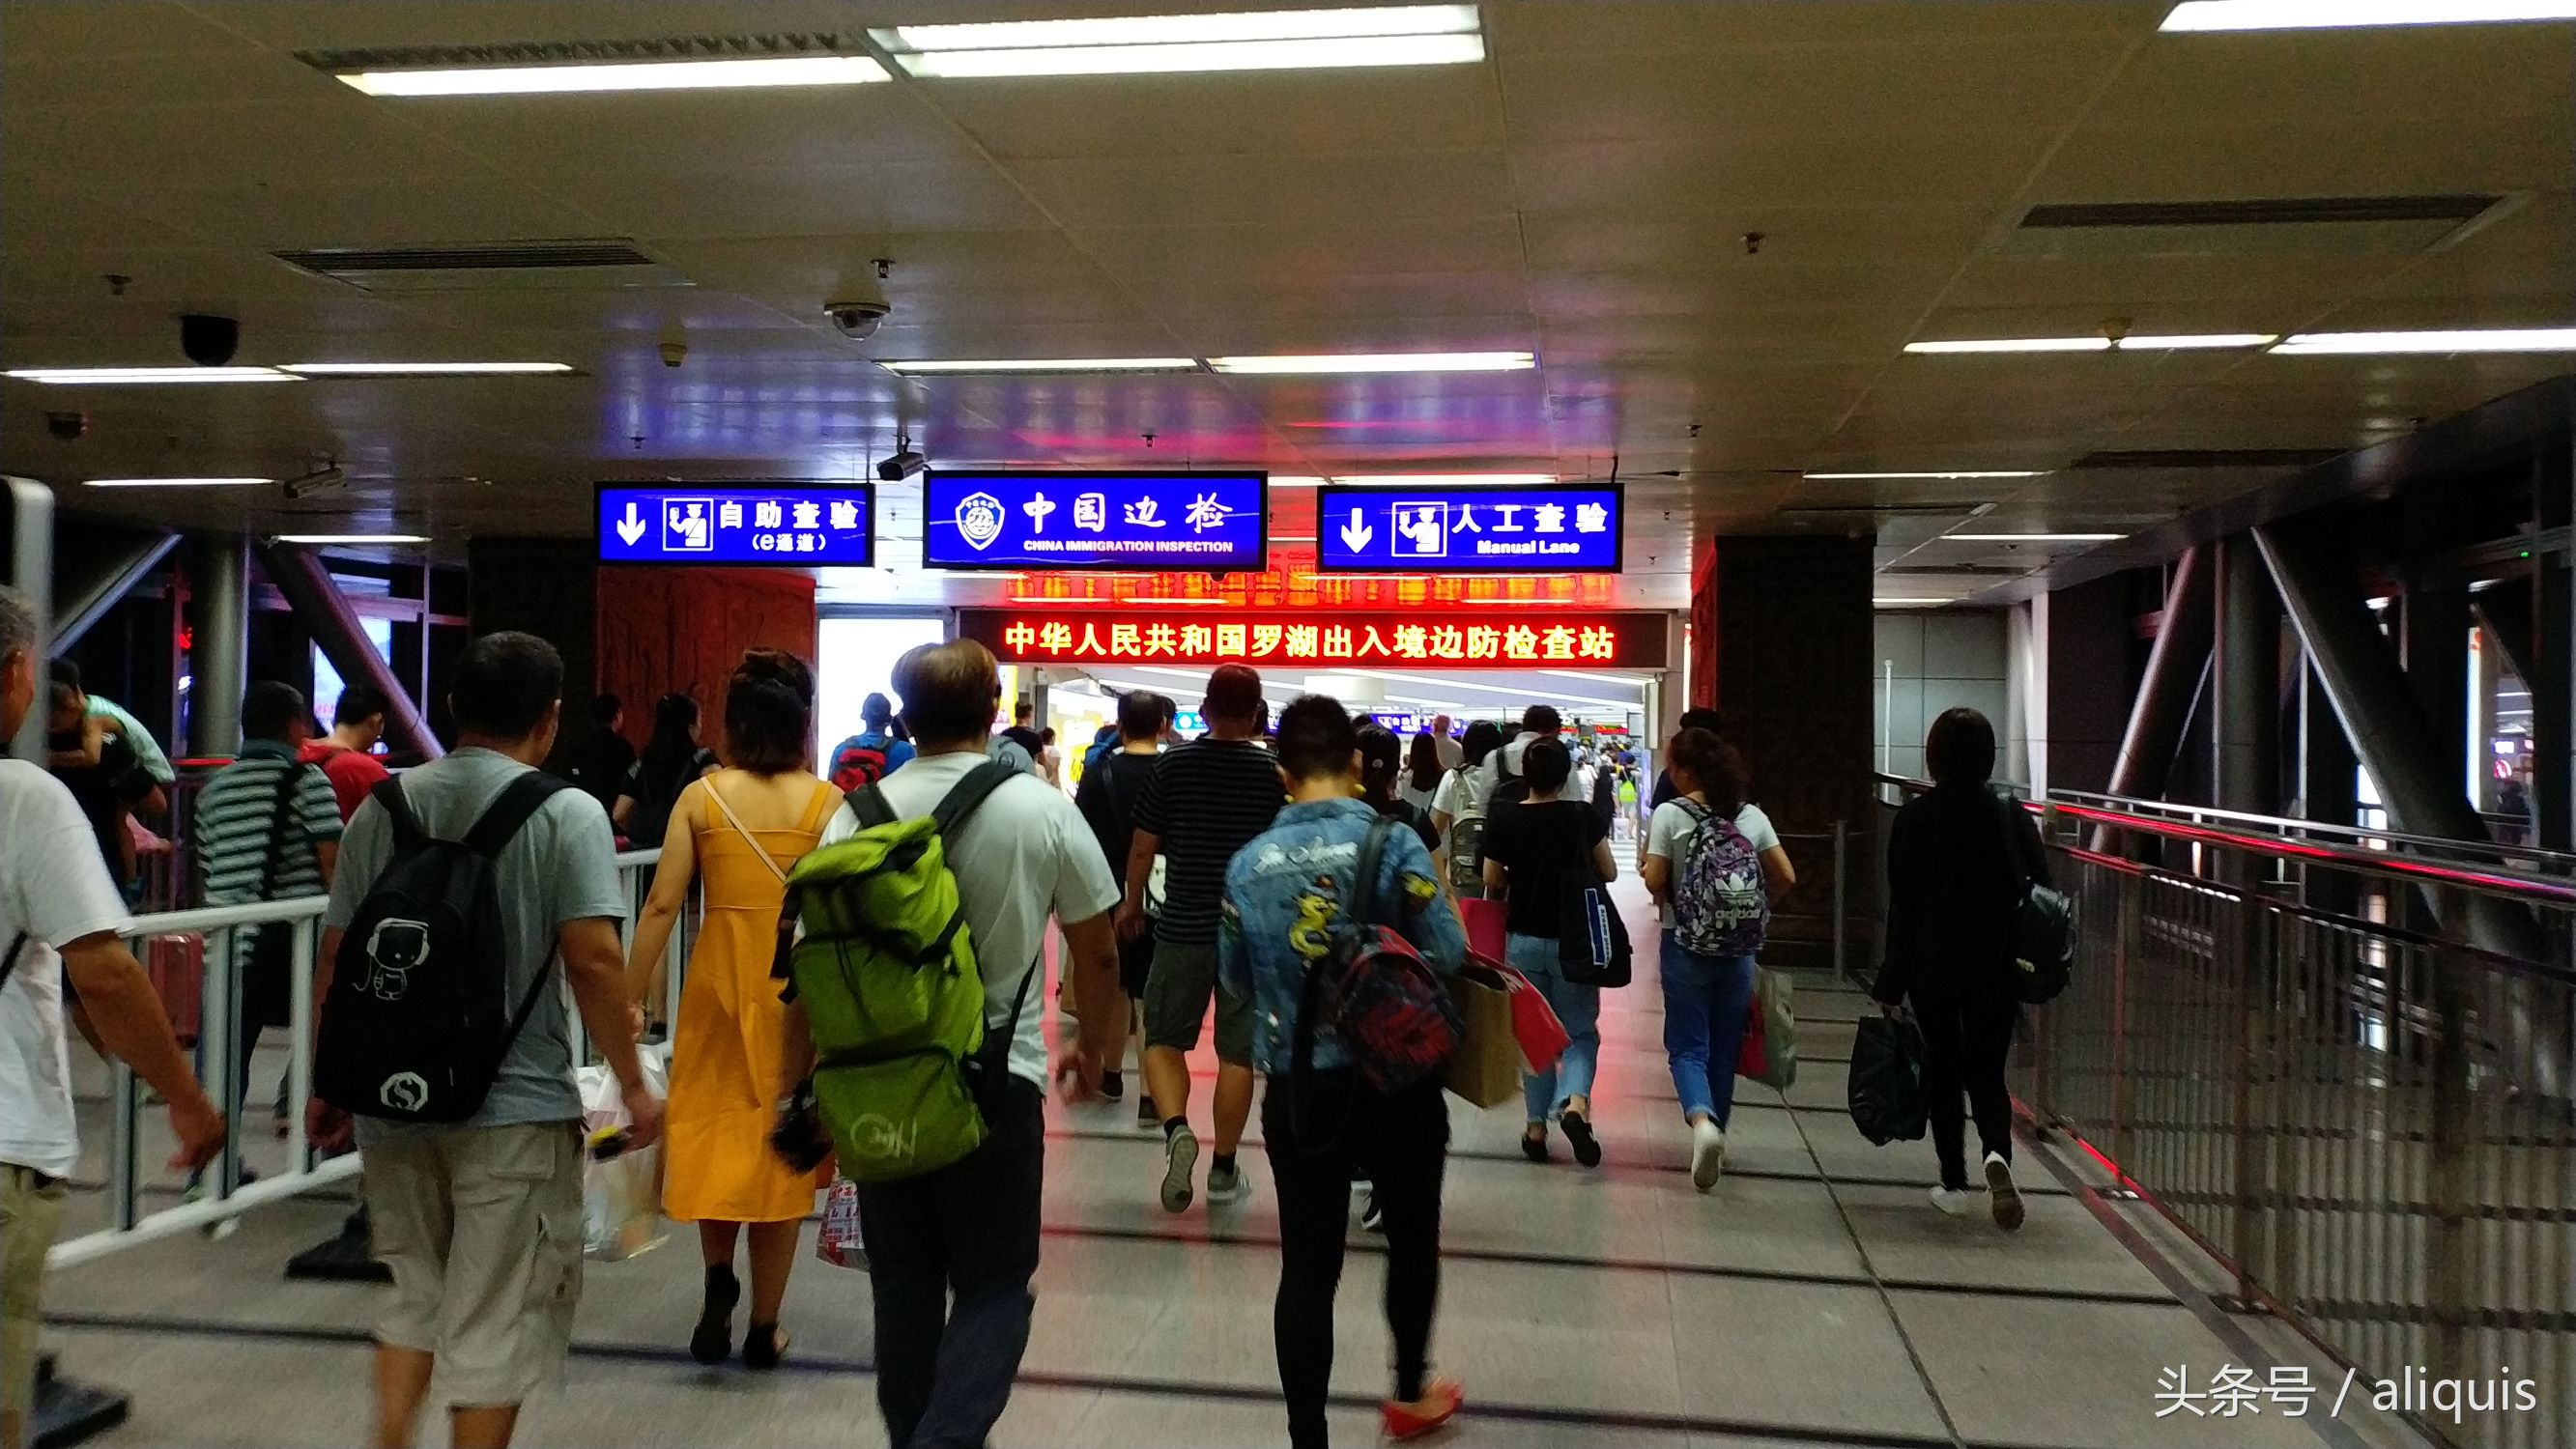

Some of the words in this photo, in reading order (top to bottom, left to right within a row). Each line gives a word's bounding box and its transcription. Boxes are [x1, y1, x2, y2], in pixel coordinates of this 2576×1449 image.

[720, 499, 859, 529] 自助查验
[1022, 491, 1234, 534] 中国边检
[1451, 502, 1609, 533] 人工查验
[1023, 539, 1065, 552] CHINA
[1066, 540, 1155, 553] IMMIGRATION
[1156, 541, 1234, 553] INSPECTION
[1476, 539, 1537, 554] Manual
[1538, 540, 1581, 554] Lane
[1005, 621, 1615, 659] 中华人民共和国罗湖出入境边防检查站
